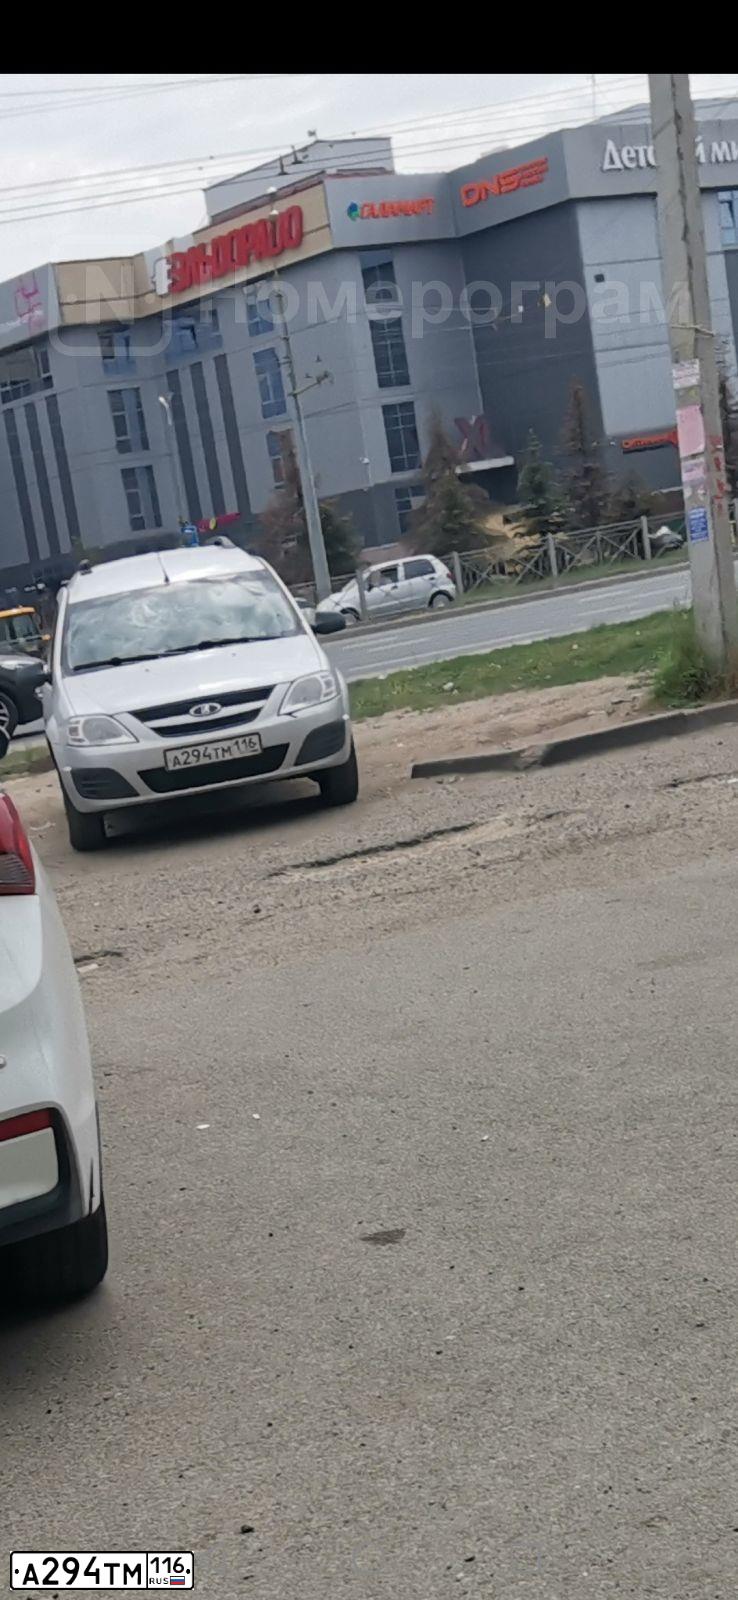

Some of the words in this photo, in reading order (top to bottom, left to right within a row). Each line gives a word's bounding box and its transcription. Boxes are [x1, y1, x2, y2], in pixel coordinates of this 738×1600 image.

[461, 171, 520, 207] DNS
[172, 746, 231, 767] А294ТМ
[234, 737, 257, 751] 116
